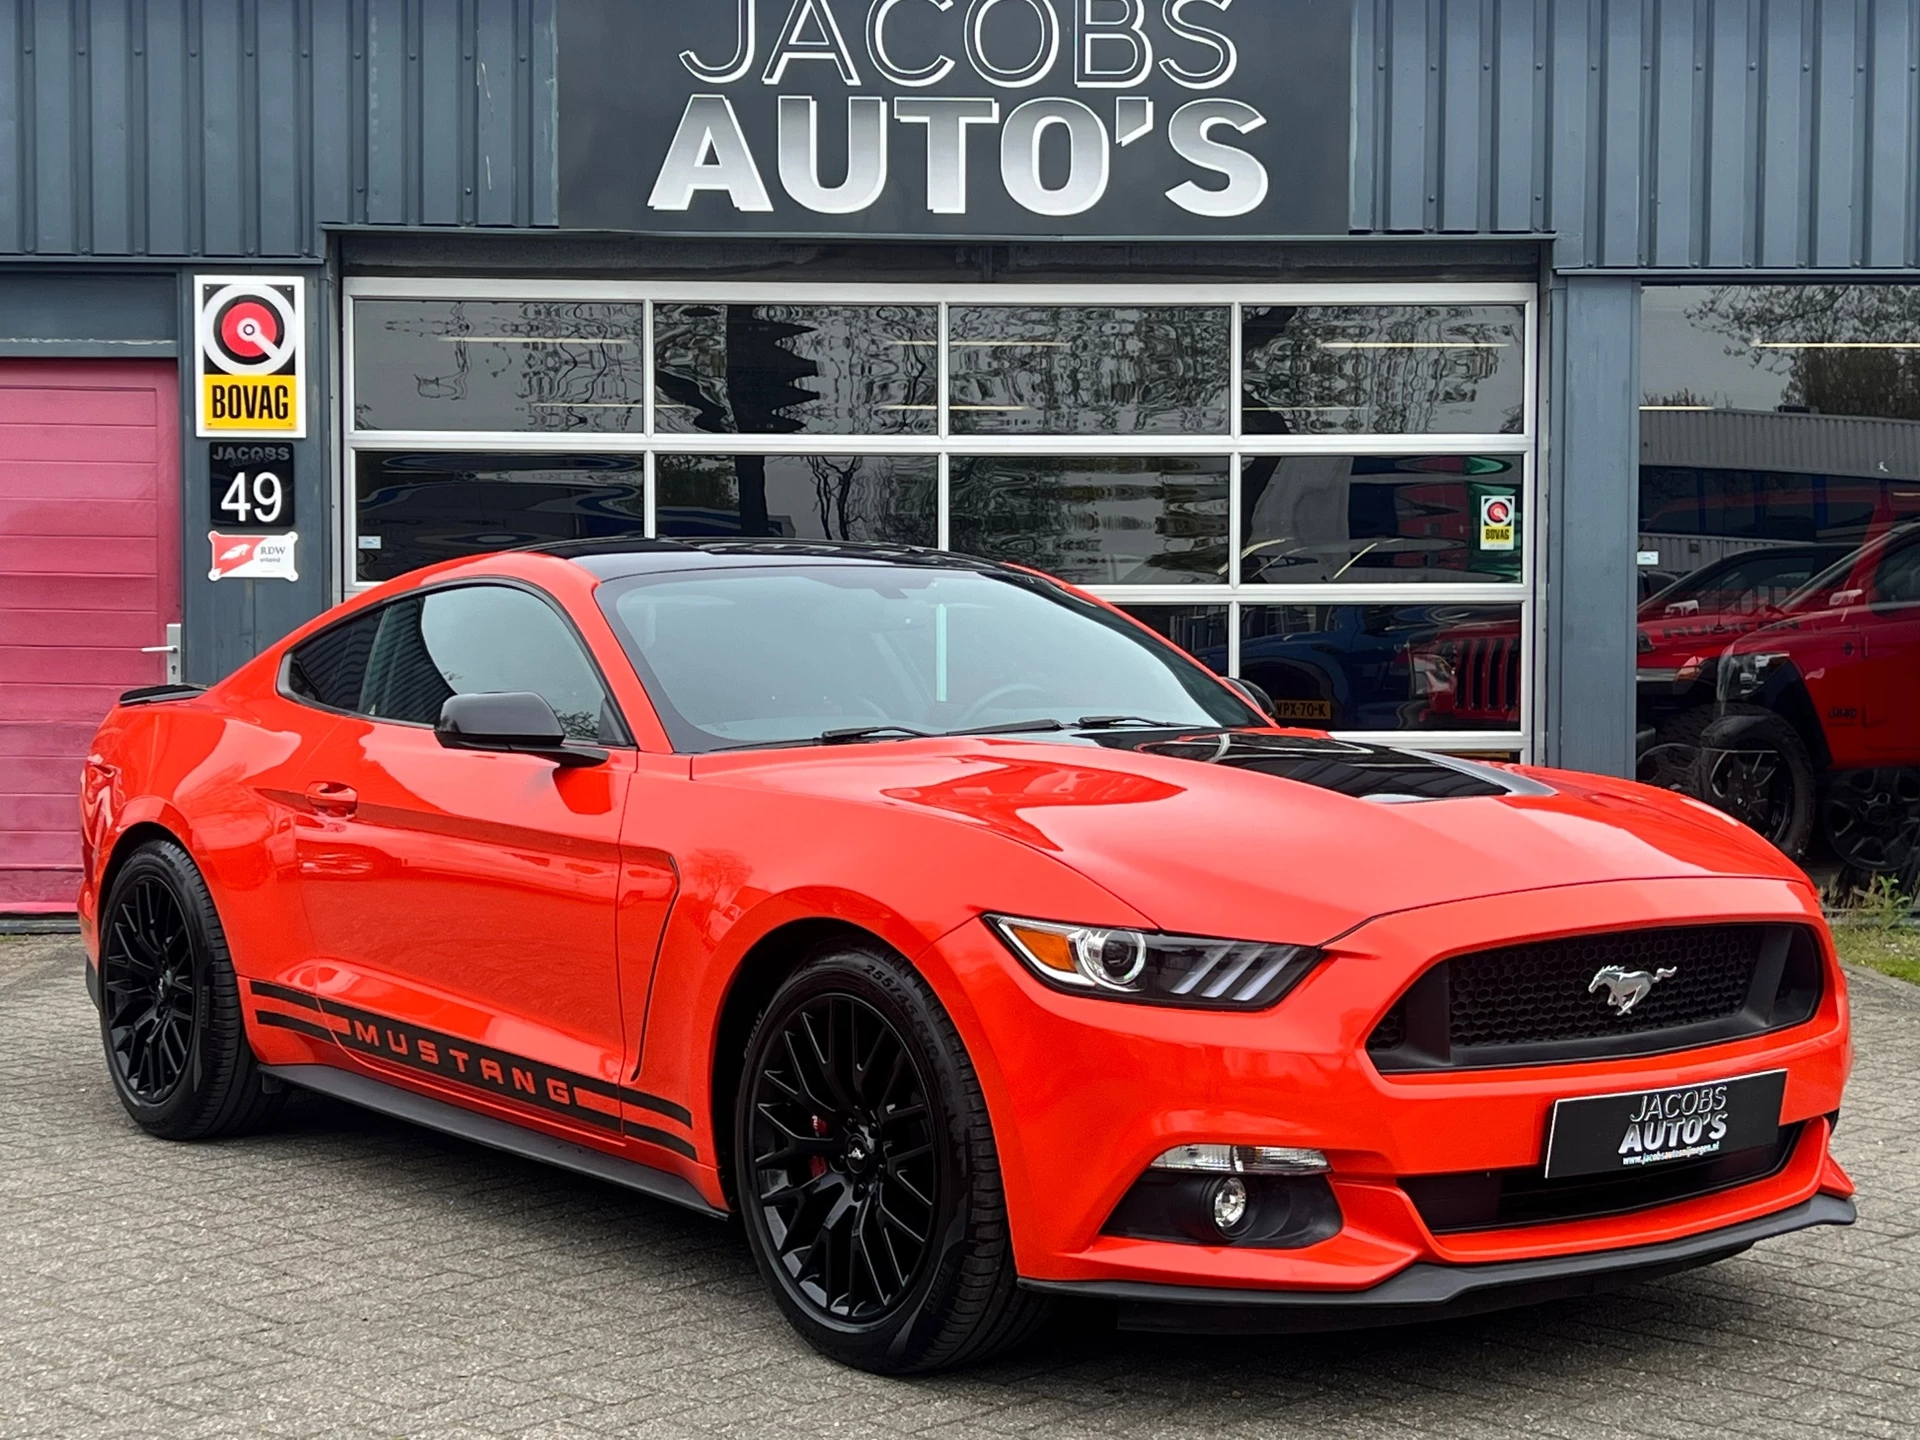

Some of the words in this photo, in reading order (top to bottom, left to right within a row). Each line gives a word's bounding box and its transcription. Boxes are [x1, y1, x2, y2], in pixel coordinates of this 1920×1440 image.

[678, 0, 1238, 88] JACOBS
[647, 94, 1269, 217] AUTO'S
[212, 384, 289, 420] BOVAG
[212, 446, 290, 460] JACOBS
[220, 471, 283, 522] 49
[260, 546, 286, 555] RDW
[1485, 528, 1510, 540] BOVAG
[353, 1020, 571, 1104] MUSTANG
[1628, 1085, 1728, 1122] JACOBS
[1618, 1112, 1729, 1155] AUTO'S
